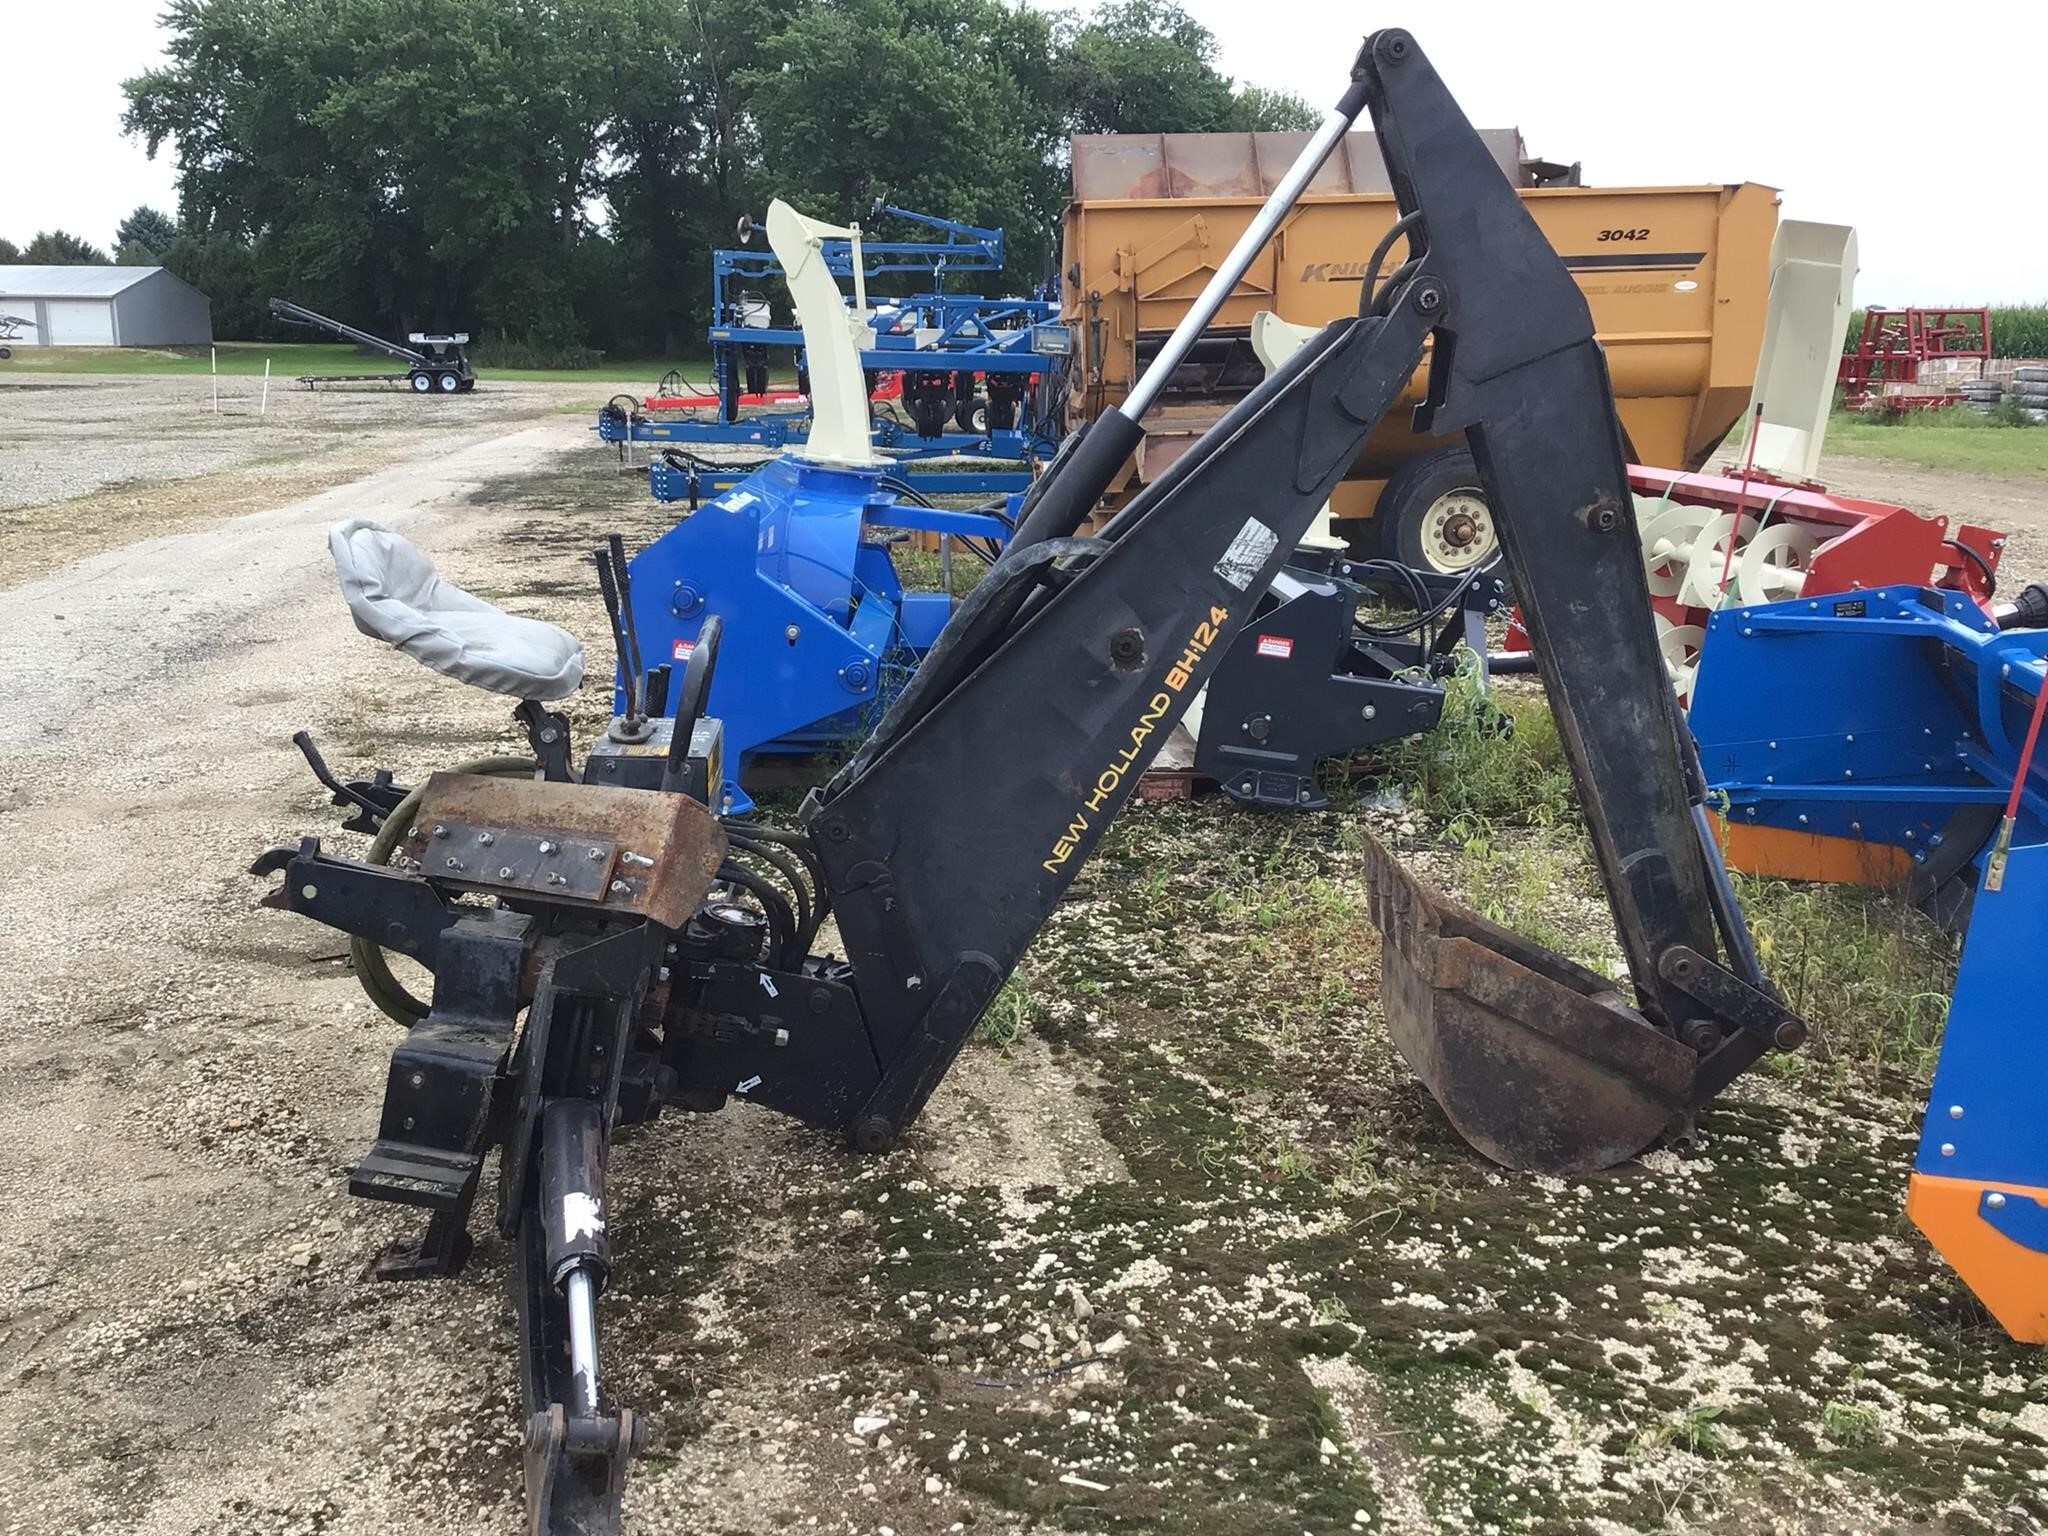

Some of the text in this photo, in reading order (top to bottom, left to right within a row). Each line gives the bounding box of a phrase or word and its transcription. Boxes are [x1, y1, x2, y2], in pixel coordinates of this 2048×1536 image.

[1597, 229, 1650, 242] 3042
[1042, 812, 1090, 874] NEW
[1084, 691, 1171, 812] HOLLAND
